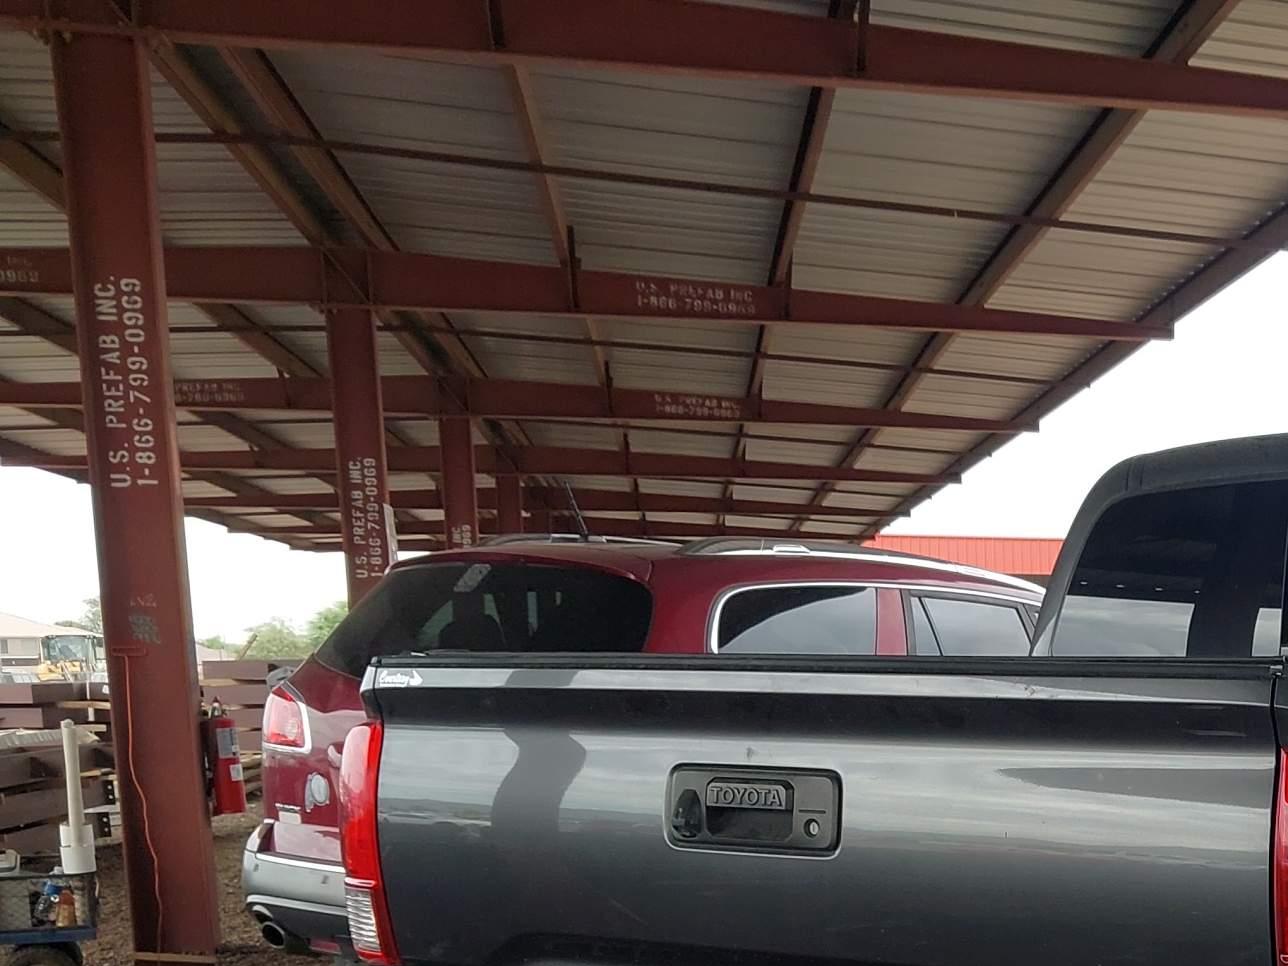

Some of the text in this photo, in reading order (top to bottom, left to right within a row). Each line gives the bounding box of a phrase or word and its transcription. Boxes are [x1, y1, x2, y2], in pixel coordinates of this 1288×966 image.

[94, 276, 131, 488] U.S. PREFAB INC.
[119, 277, 159, 486] 1-866-799-0969
[351, 490, 367, 545] PREFAB
[711, 785, 783, 807] TOYOTA
